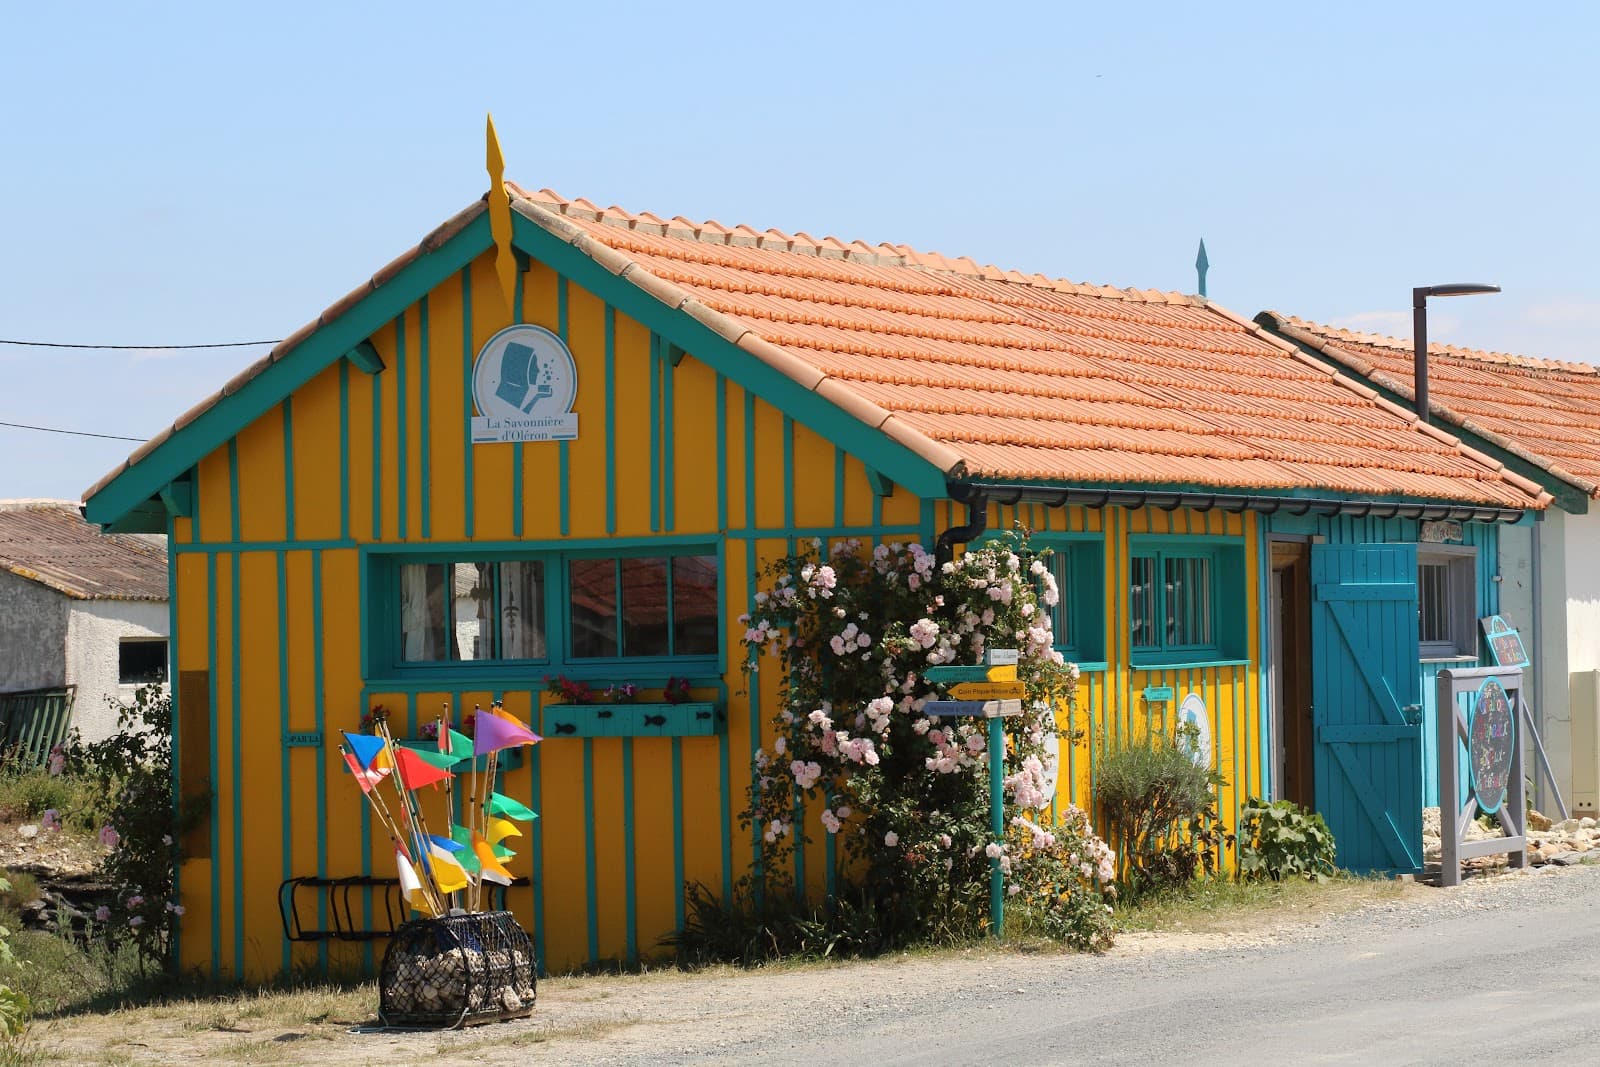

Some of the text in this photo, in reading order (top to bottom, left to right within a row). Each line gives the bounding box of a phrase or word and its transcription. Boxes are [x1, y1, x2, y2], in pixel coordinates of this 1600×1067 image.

[487, 415, 564, 429] La Savonnière
[502, 429, 549, 441] d'Oléron
